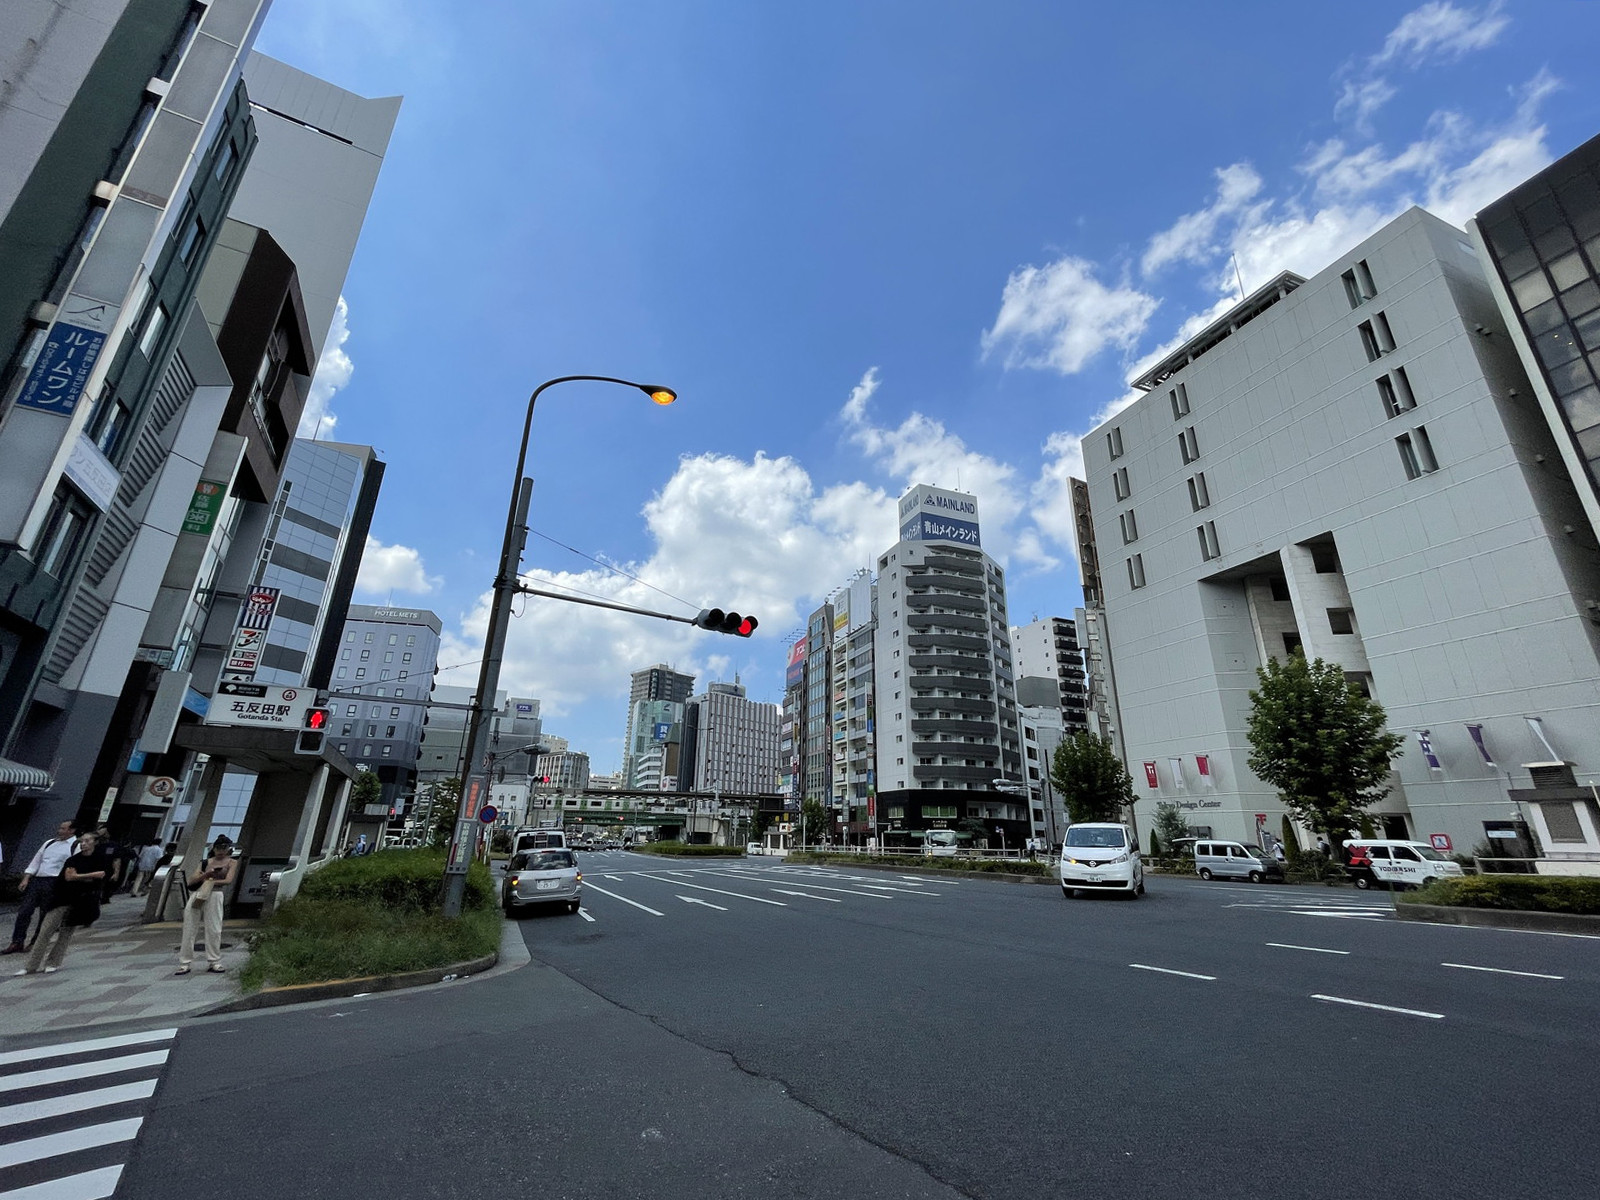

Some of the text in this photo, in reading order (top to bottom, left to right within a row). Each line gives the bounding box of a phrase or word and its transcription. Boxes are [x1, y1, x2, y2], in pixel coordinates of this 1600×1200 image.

[37, 331, 89, 404] ルームワン
[936, 495, 975, 514] MAINLAND
[924, 520, 977, 542] 青山メインランド
[230, 701, 291, 716] 五反田駅
[237, 712, 269, 722] Gotanda
[1199, 799, 1221, 808] Center
